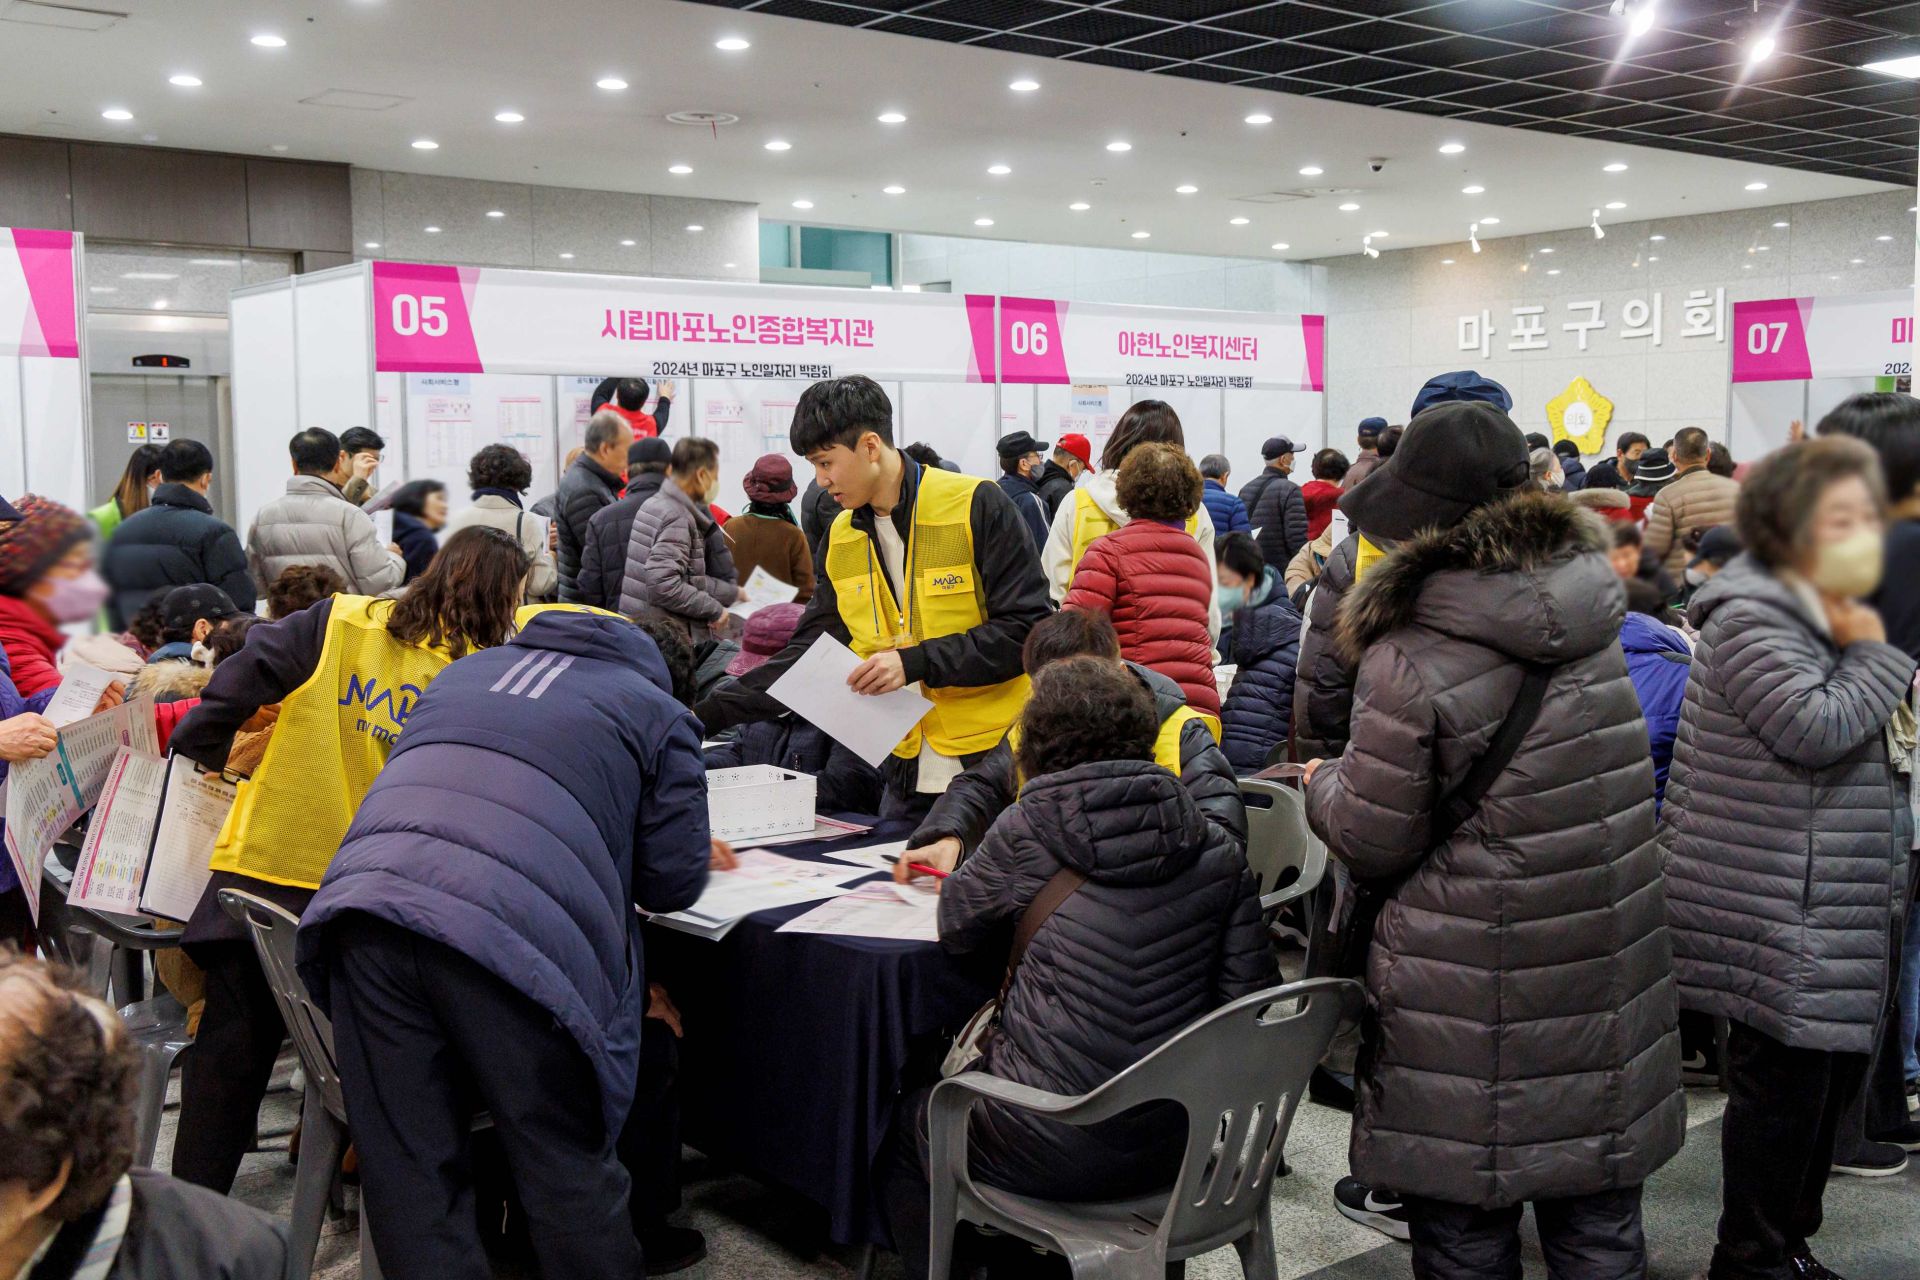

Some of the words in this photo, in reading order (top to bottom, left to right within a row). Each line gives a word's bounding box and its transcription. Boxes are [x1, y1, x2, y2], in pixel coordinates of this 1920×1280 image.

[391, 294, 449, 337] 05
[601, 308, 875, 348] 시립마포노인종합복지관
[1458, 287, 1725, 358] 마포구의회
[1011, 321, 1048, 356] 06
[1118, 331, 1258, 361] 아현노인복지센터
[1747, 322, 1789, 354] 07
[653, 362, 699, 377] 2024년
[702, 363, 737, 377] 마포구
[741, 363, 796, 378] 노인일자리
[799, 364, 832, 379] 박람회
[1125, 373, 1158, 386] 2024년
[1160, 374, 1185, 387] 마포구
[1187, 375, 1227, 388] 노인일자리
[1228, 375, 1253, 389] 박람회
[1884, 362, 1913, 375] 202
[338, 674, 422, 727] MAP
